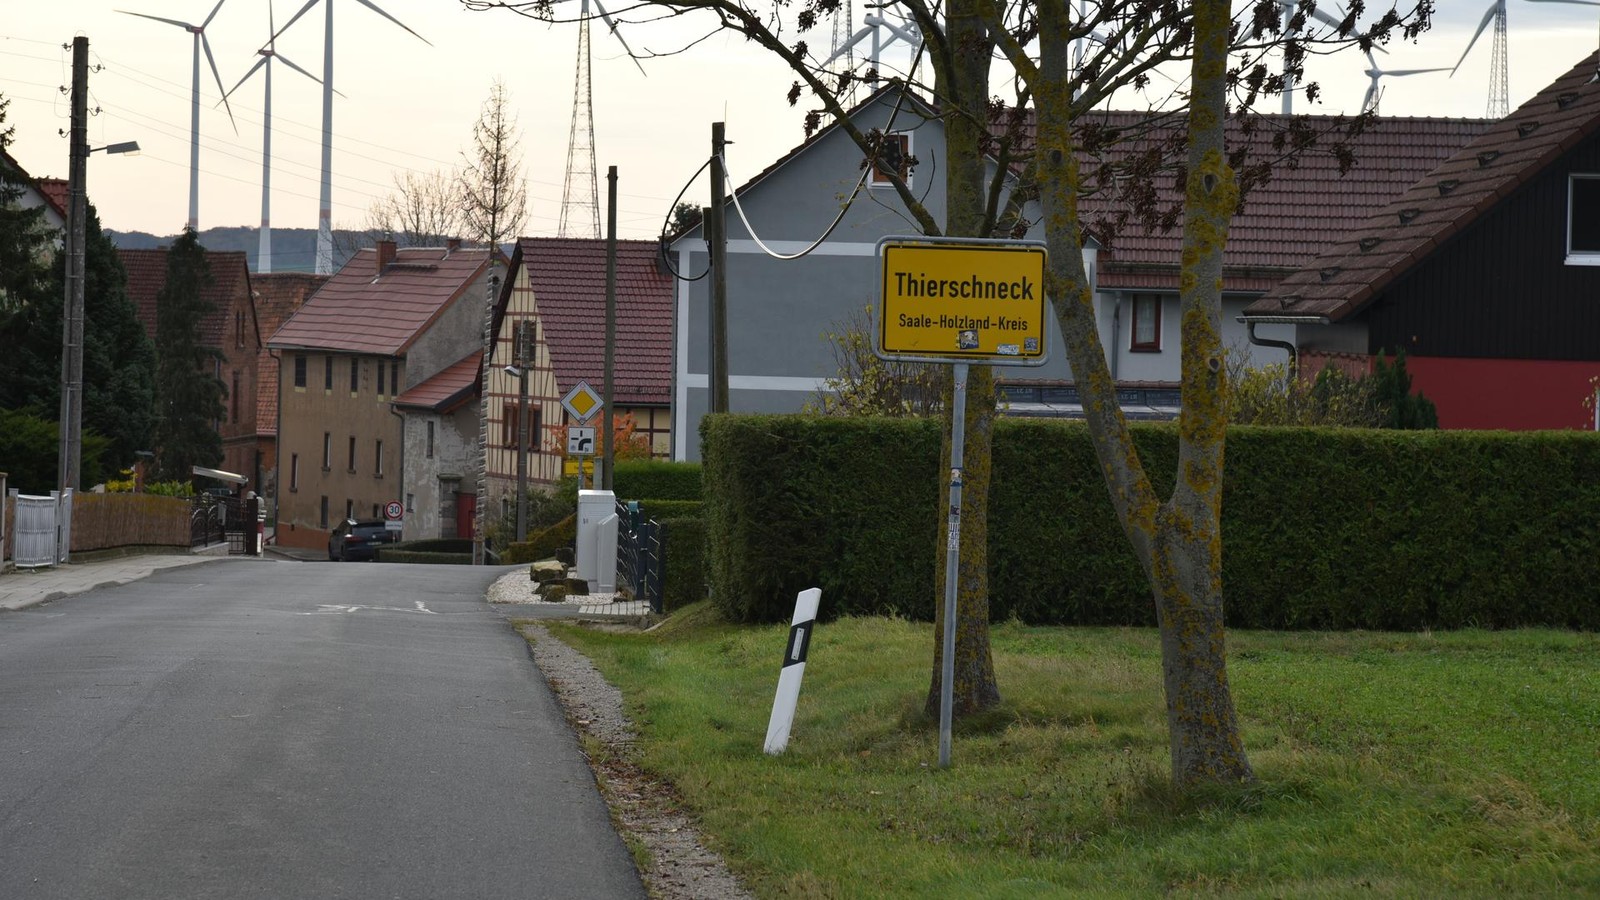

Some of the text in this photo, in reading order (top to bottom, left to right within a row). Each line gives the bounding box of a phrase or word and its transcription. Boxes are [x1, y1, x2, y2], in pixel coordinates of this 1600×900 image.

[895, 272, 1034, 300] Thierschneck
[899, 313, 1028, 331] Saale-Holzland-Kreis
[389, 505, 400, 514] 30
